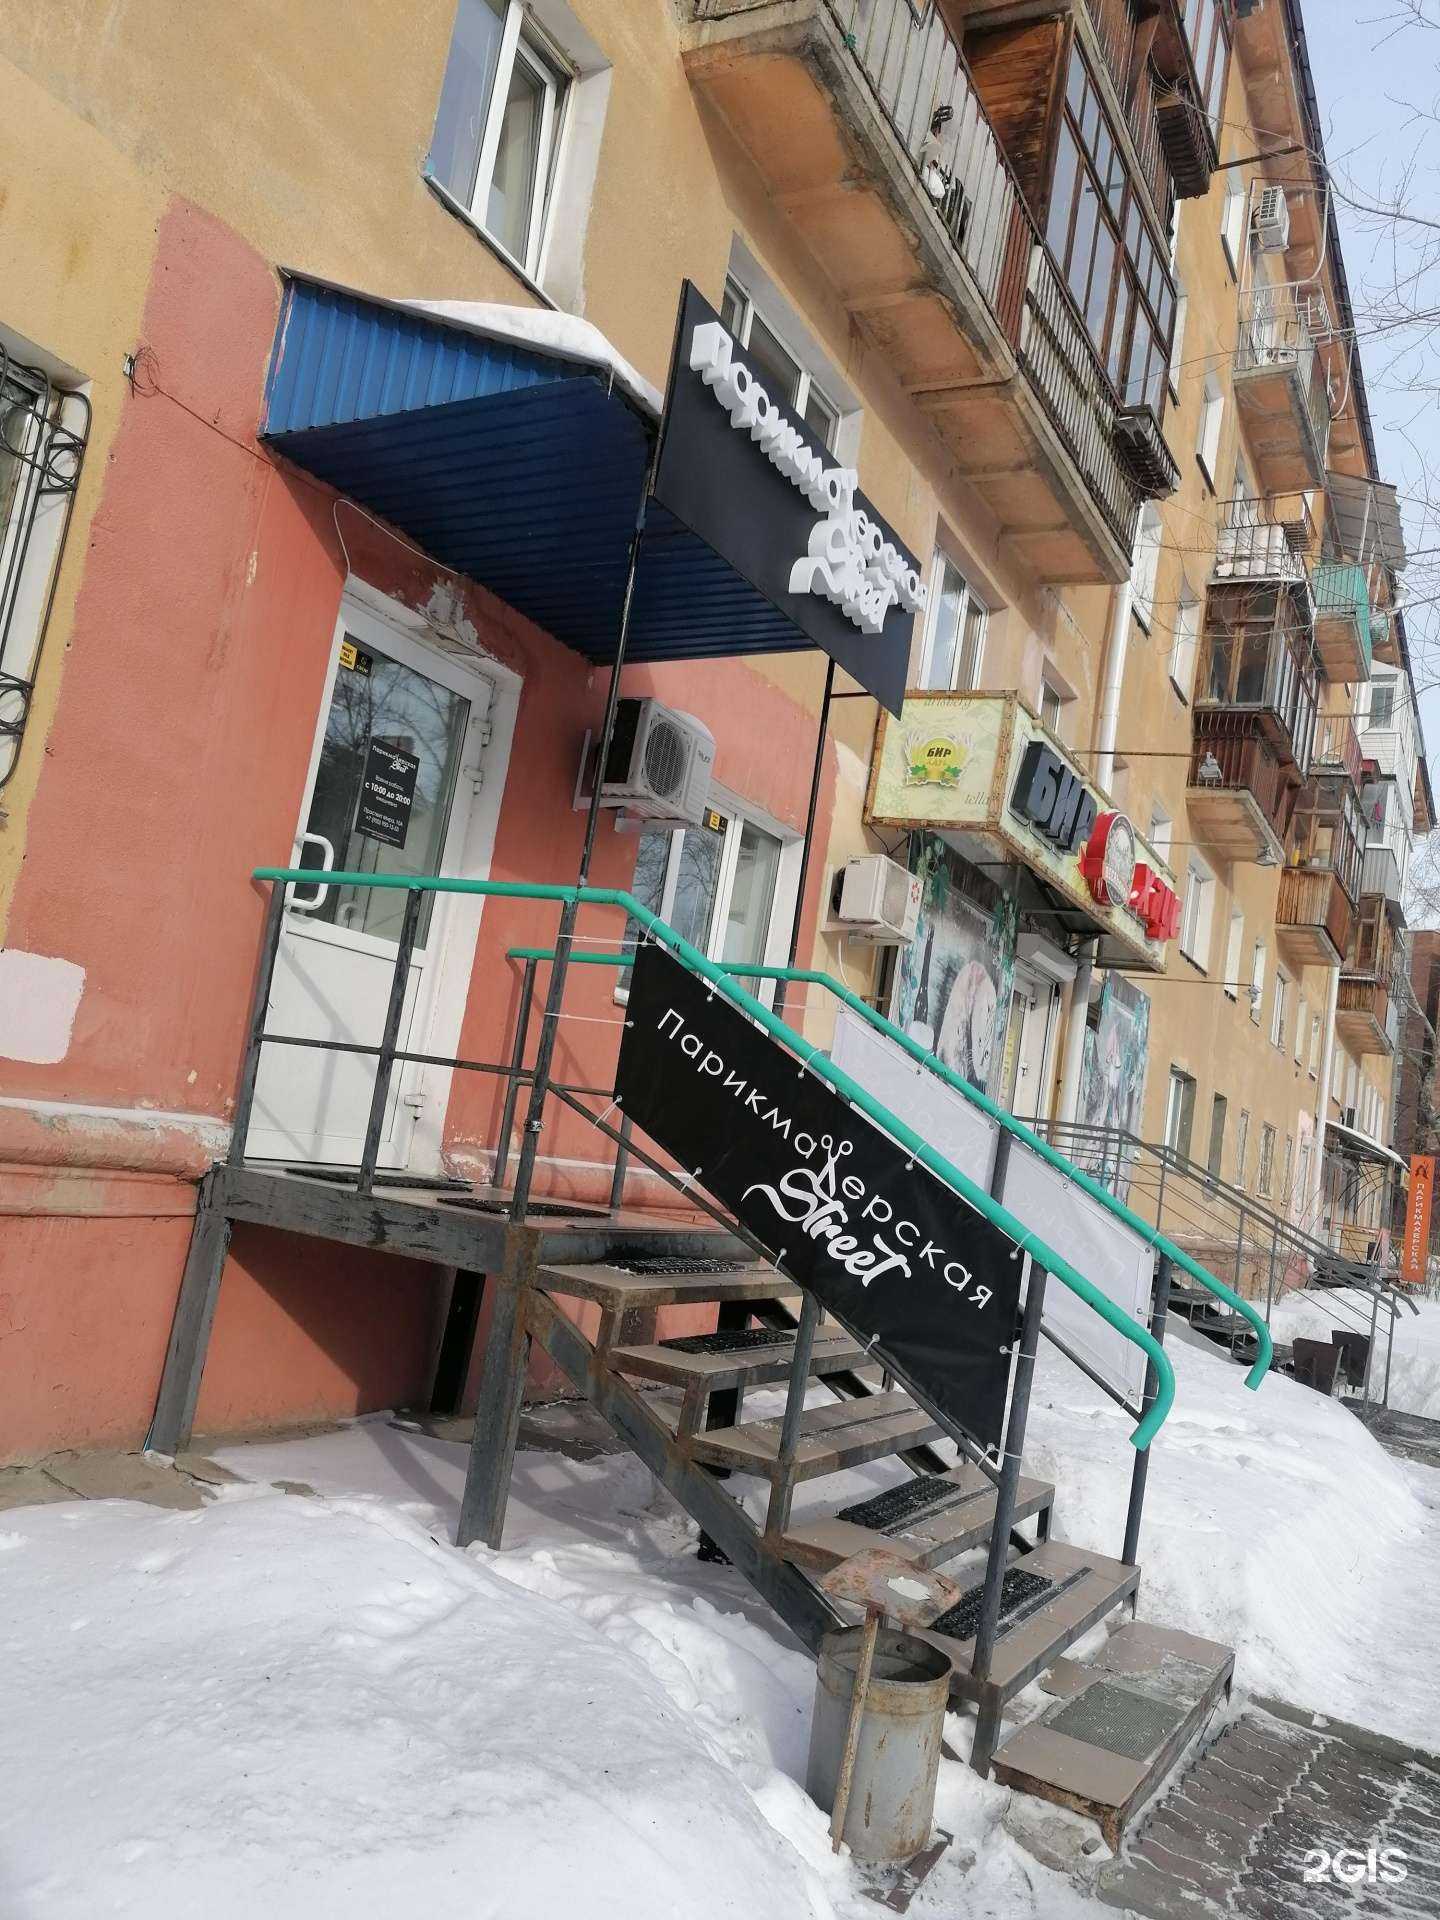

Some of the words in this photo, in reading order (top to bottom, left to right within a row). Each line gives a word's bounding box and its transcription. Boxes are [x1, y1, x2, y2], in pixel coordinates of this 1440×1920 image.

[926, 748, 952, 758] БИР
[1010, 740, 1098, 857] БИР
[741, 1168, 912, 1288] Street
[1410, 1183, 1425, 1270] ПАРИКМАХЕРСКАЯ
